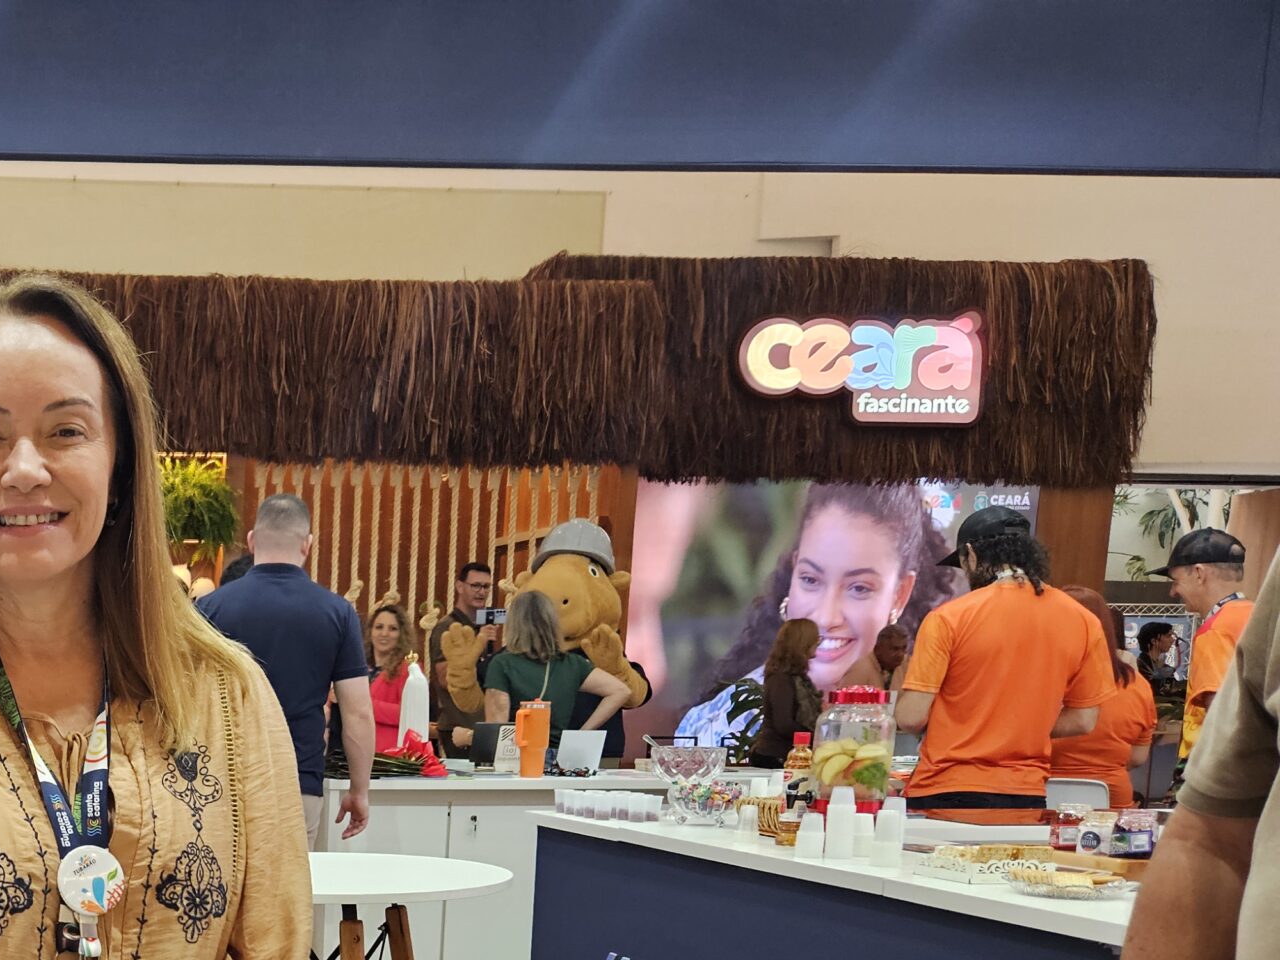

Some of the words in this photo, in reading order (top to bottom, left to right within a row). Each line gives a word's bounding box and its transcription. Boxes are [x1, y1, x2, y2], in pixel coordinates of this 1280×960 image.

[746, 317, 974, 390] ceará
[856, 392, 970, 414] fascinante
[990, 492, 1030, 506] CEARÁ
[86, 794, 94, 817] santa
[93, 781, 101, 817] catarina
